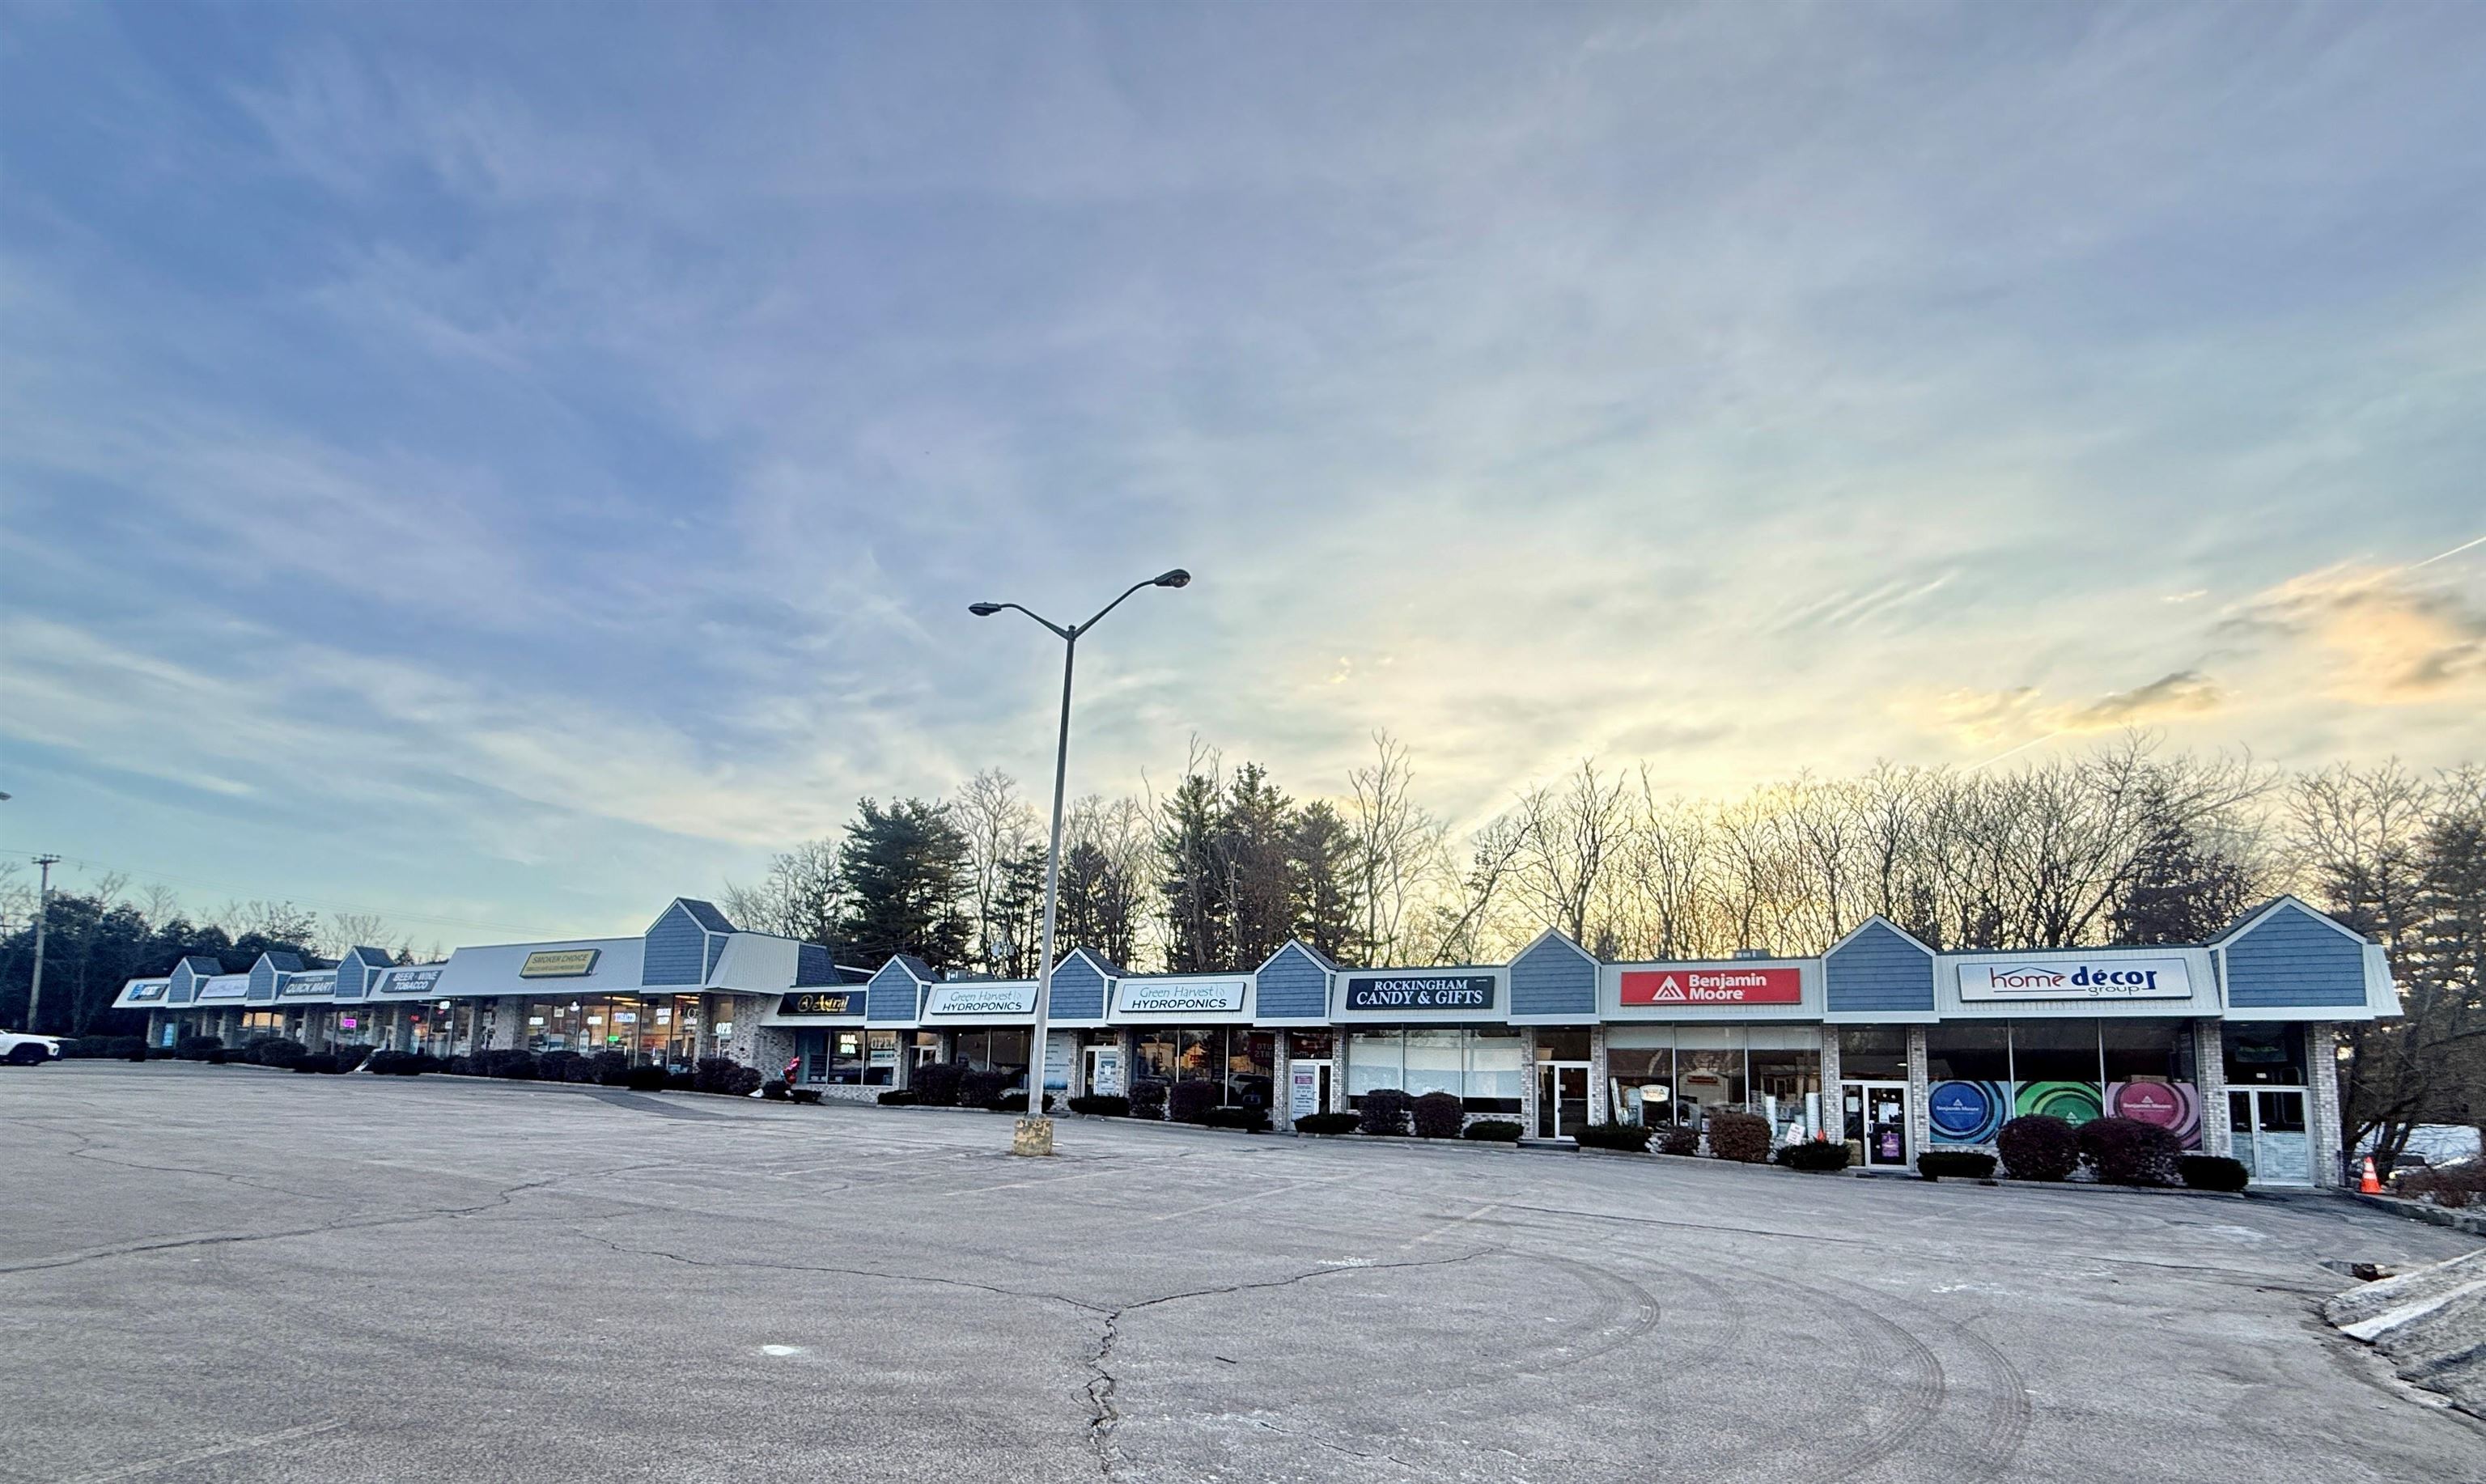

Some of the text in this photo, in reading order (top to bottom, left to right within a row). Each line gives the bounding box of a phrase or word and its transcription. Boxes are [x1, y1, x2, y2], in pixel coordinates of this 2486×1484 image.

[392, 972, 415, 982] BEER
[1689, 973, 1767, 989] Benjamin
[1990, 966, 2157, 990] home décor
[310, 982, 335, 992] MART
[394, 981, 429, 990] TOBACCO
[1374, 980, 1468, 991] ROCKINGHAM
[2088, 986, 2140, 996] group
[950, 990, 1012, 1002] Green Harvest
[1140, 986, 1213, 998] Green Harvest
[1356, 990, 1483, 1005] CANDY & GIFTS
[1689, 988, 1744, 1000] Moore
[812, 994, 850, 1011] Astral
[942, 1002, 1022, 1011] HYDROPONICS
[1132, 999, 1227, 1008] HYDROPONICS
[716, 1023, 732, 1034] OPE
